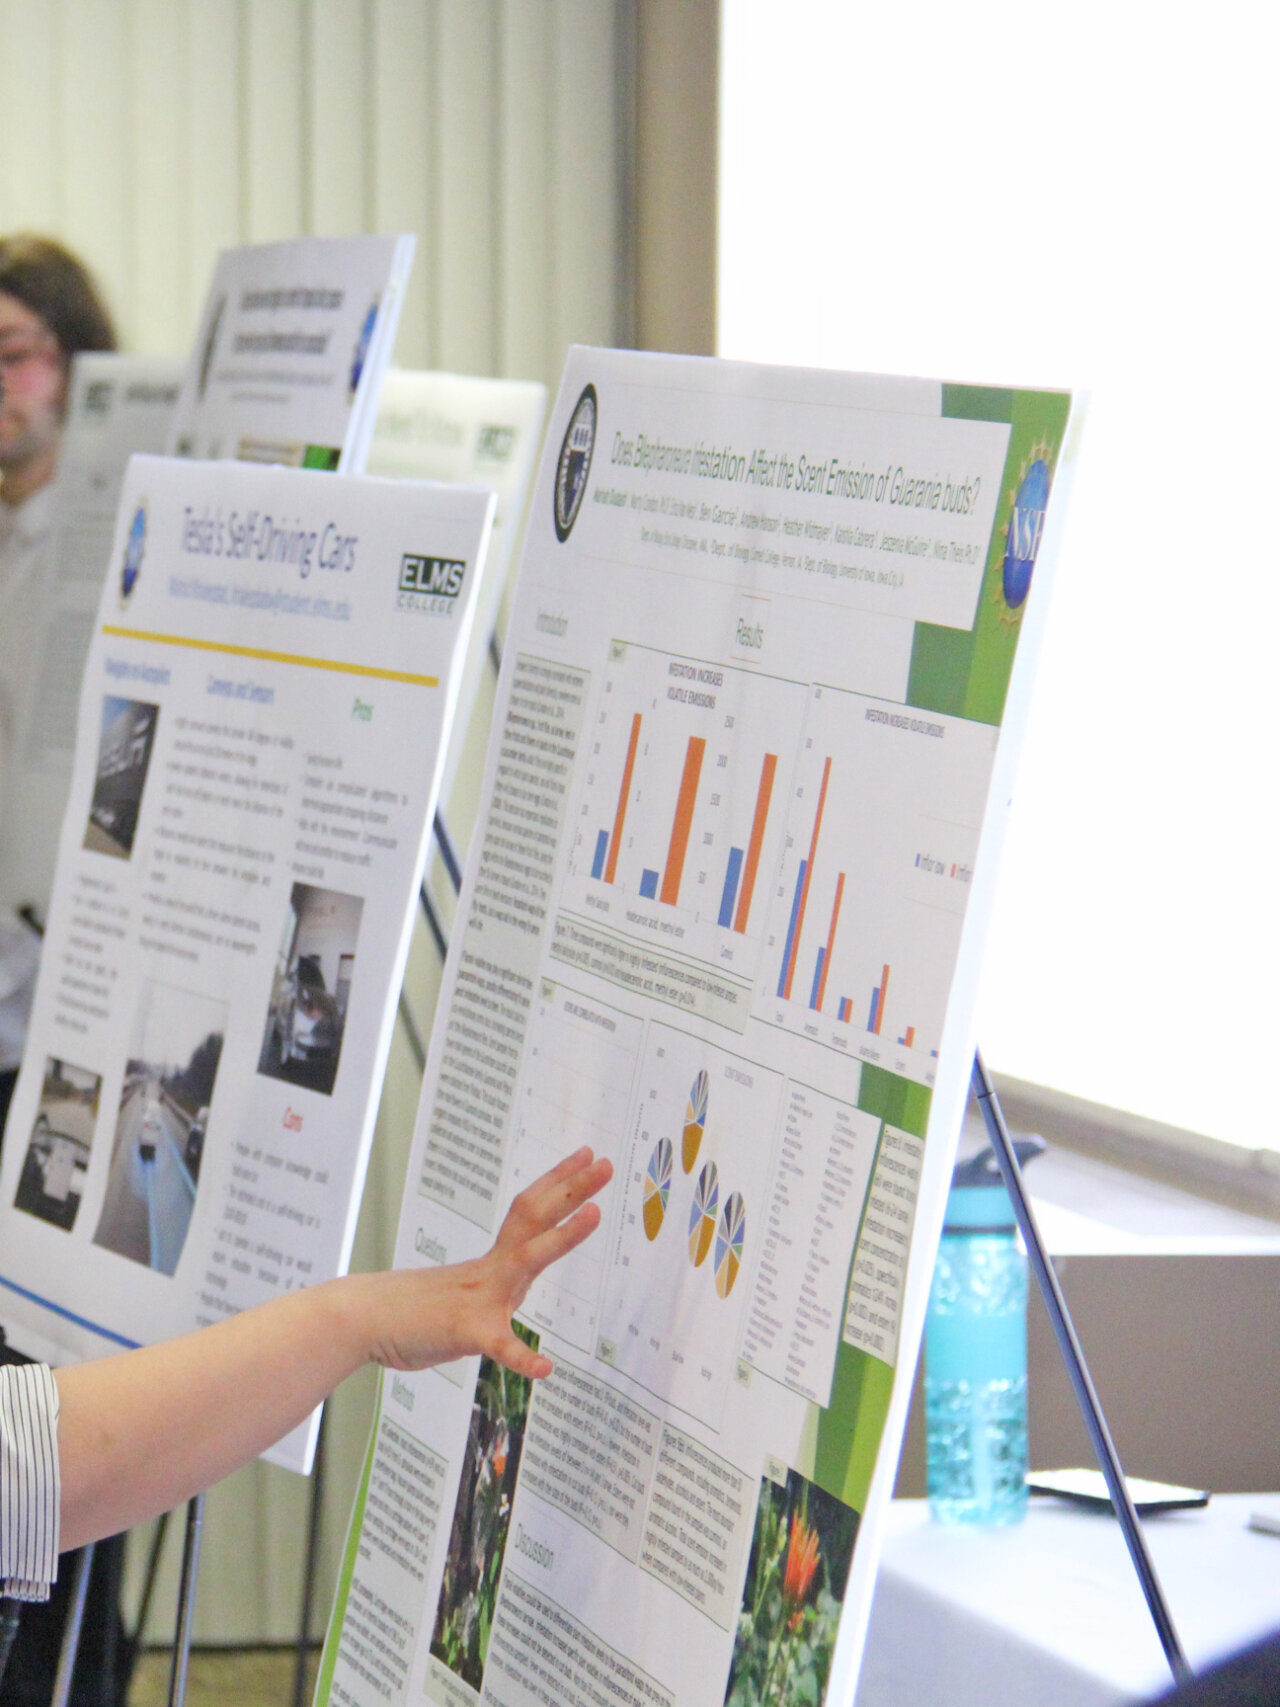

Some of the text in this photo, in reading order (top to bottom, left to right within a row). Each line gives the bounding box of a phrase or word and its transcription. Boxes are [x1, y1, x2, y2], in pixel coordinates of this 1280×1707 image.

[611, 430, 634, 467] Does
[745, 448, 777, 487] Affect
[776, 451, 794, 490] the
[795, 454, 827, 494] Scent
[826, 458, 875, 500] Emission
[875, 465, 892, 504] of
[942, 471, 981, 516] buds?
[183, 506, 360, 580] Tesla's Self-Driving Cars
[1004, 507, 1046, 561] NSF
[400, 556, 464, 595] ELMS
[396, 594, 456, 614] COLLEGE
[735, 617, 764, 649] Results
[351, 697, 374, 722] Pros
[282, 1106, 304, 1132] Cons
[514, 1522, 554, 1571] Discussion
